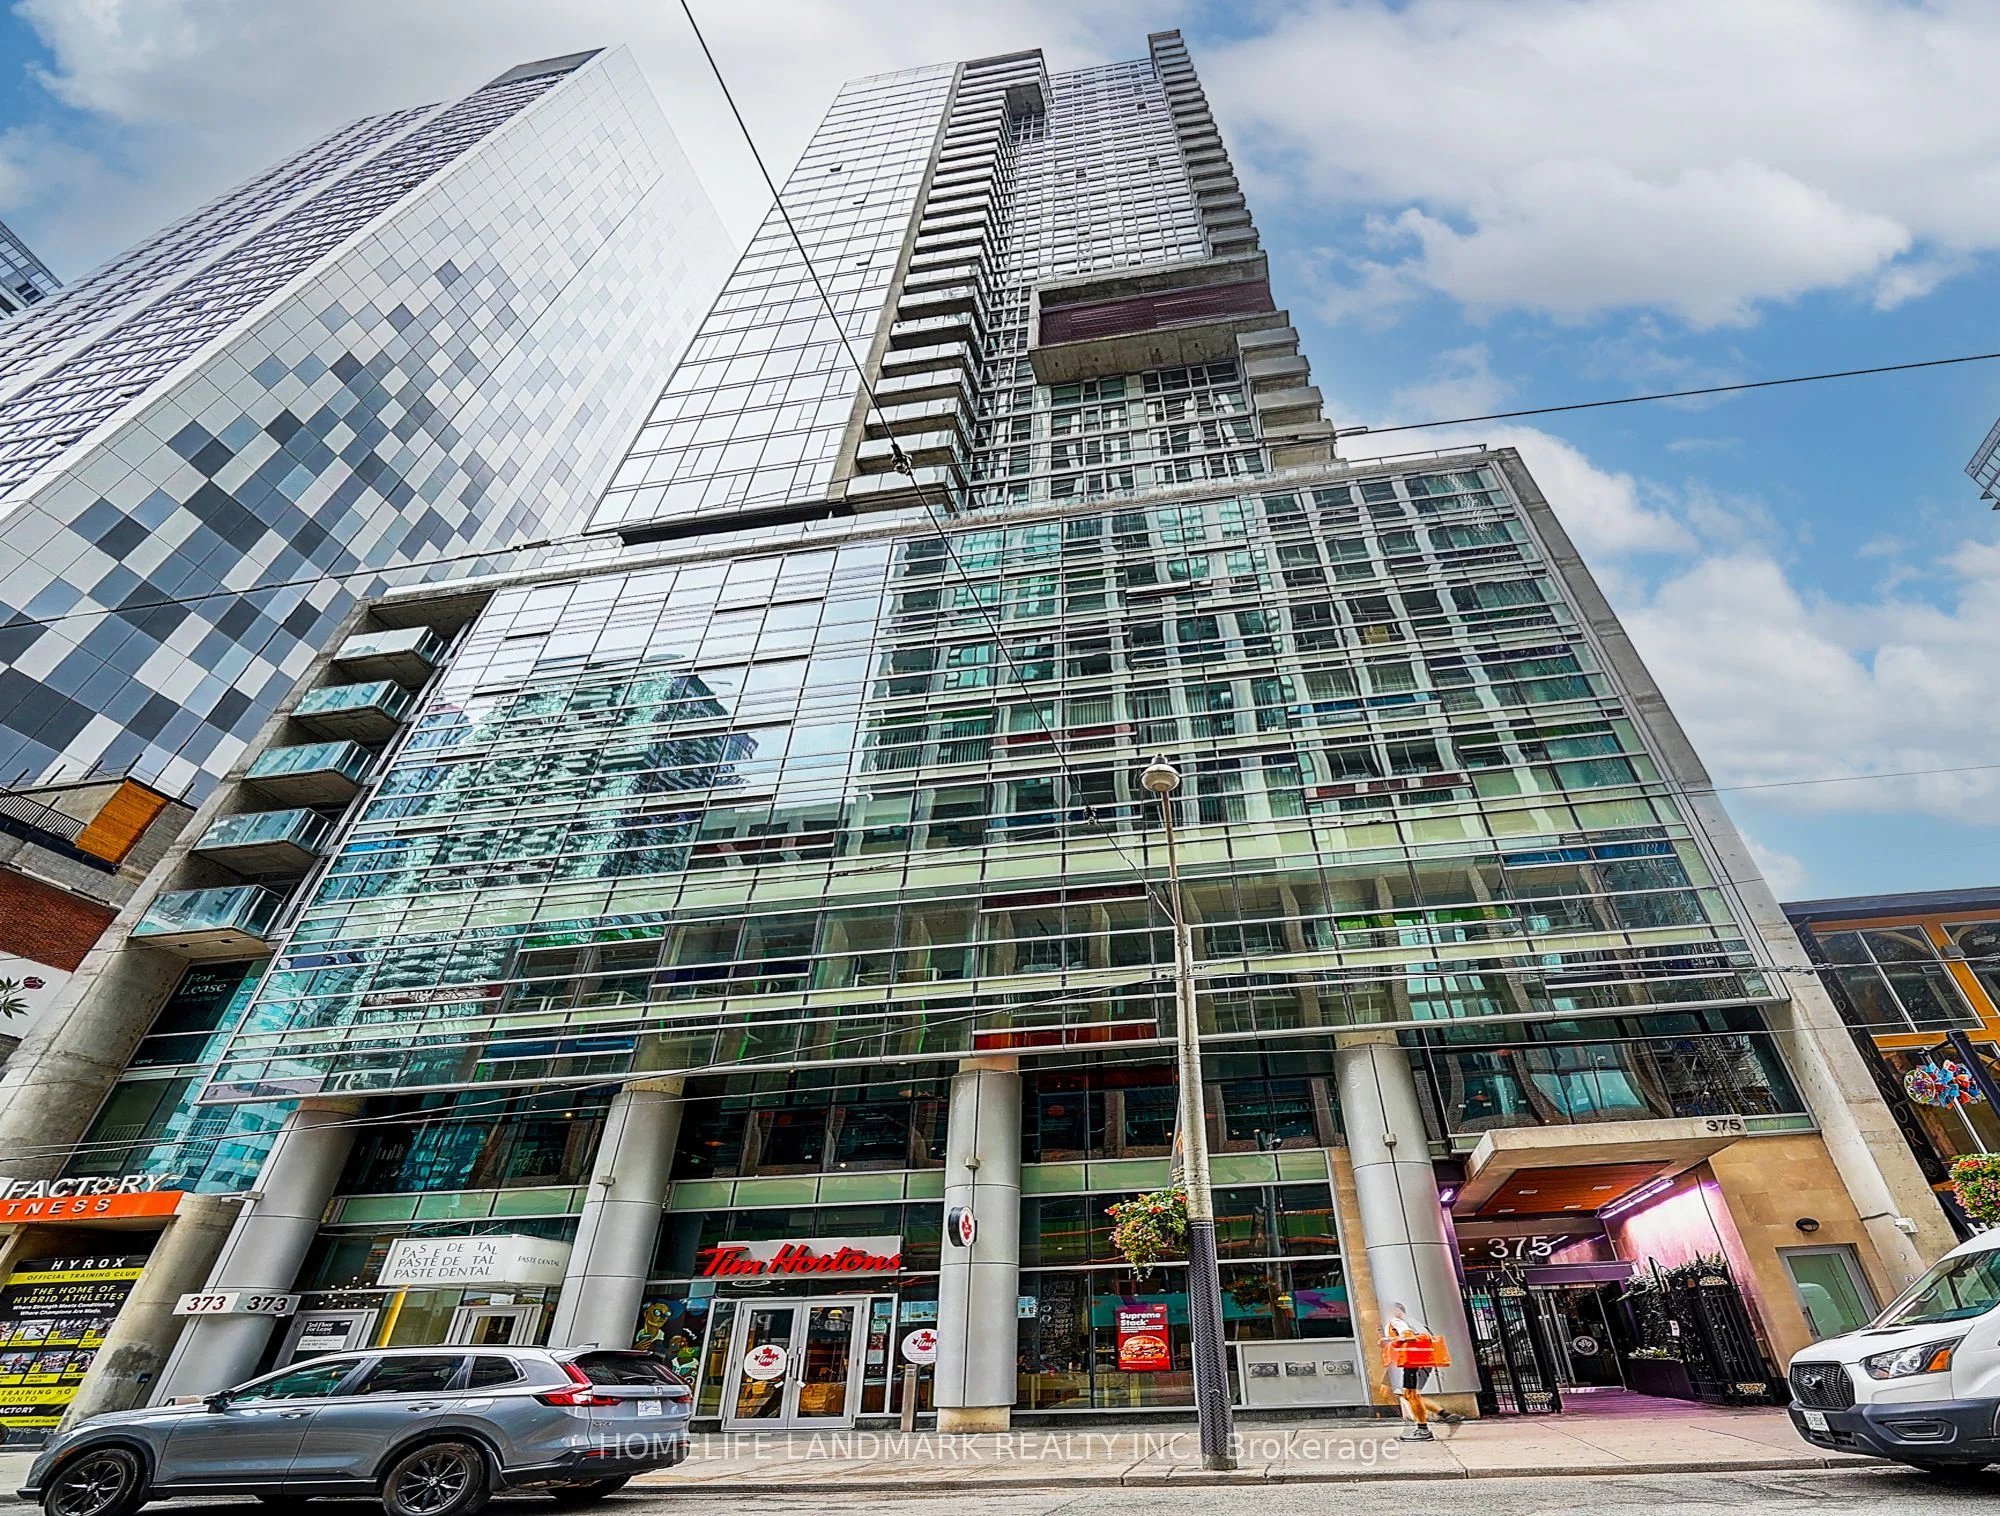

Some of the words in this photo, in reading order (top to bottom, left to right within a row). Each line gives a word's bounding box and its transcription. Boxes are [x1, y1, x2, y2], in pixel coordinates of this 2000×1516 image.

[186, 973, 216, 985] For
[179, 983, 227, 995] Lease
[1859, 1039, 1924, 1147] MANOR
[1706, 1119, 1742, 1131] 375
[3, 1172, 172, 1200] FACTORY
[6, 1198, 112, 1216] TNESS
[1487, 1235, 1553, 1260] 375
[50, 1257, 126, 1271] HYROX
[397, 1257, 437, 1268] PASTE
[537, 1257, 561, 1267] DENTAL
[702, 1246, 766, 1277] Tim
[767, 1243, 903, 1274] Hortons
[70, 1271, 111, 1279] TRAINING
[393, 1268, 433, 1279] PASTE
[438, 1266, 492, 1277] DENTAL
[32, 1287, 55, 1295] THE
[59, 1285, 94, 1294] HOME
[99, 1285, 116, 1293] OF
[12, 1295, 58, 1304] HYBRID
[62, 1292, 125, 1302] ATHLETES
[186, 1295, 227, 1311] 373
[246, 1295, 288, 1312] 373
[1120, 1312, 1161, 1320] Supreme
[1, 1388, 52, 1396] TRAINING
